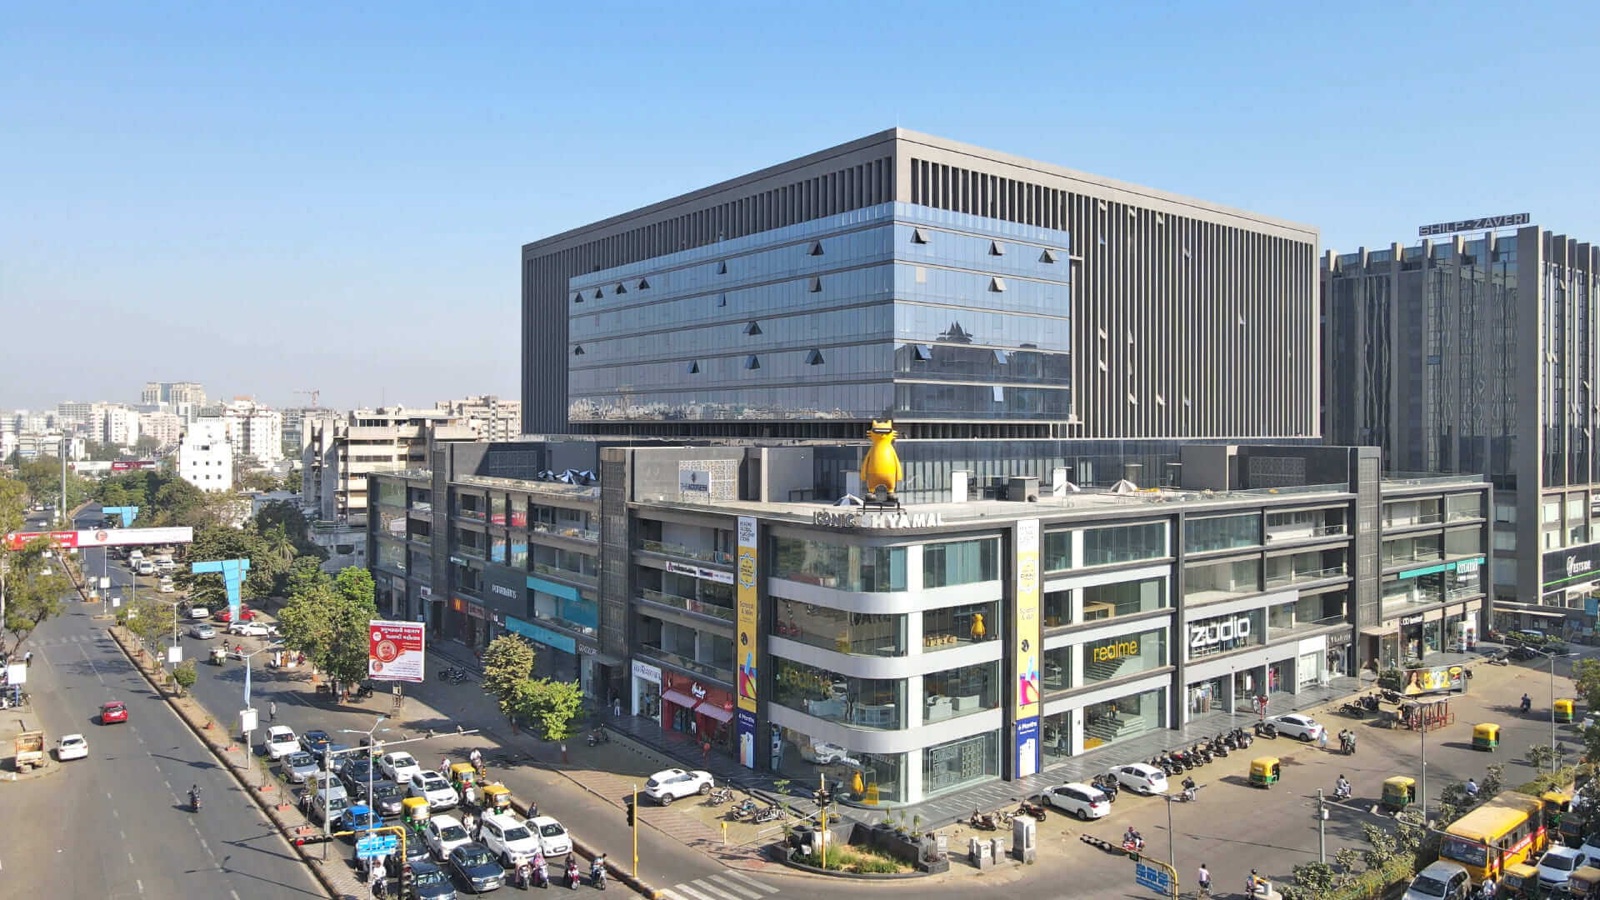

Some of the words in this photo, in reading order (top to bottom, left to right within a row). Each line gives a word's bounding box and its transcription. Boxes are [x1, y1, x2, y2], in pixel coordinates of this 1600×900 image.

[812, 511, 855, 528] ICONIC
[860, 511, 945, 528] SHYAMAL
[1190, 615, 1251, 648] zudio
[1092, 639, 1139, 663] realme
